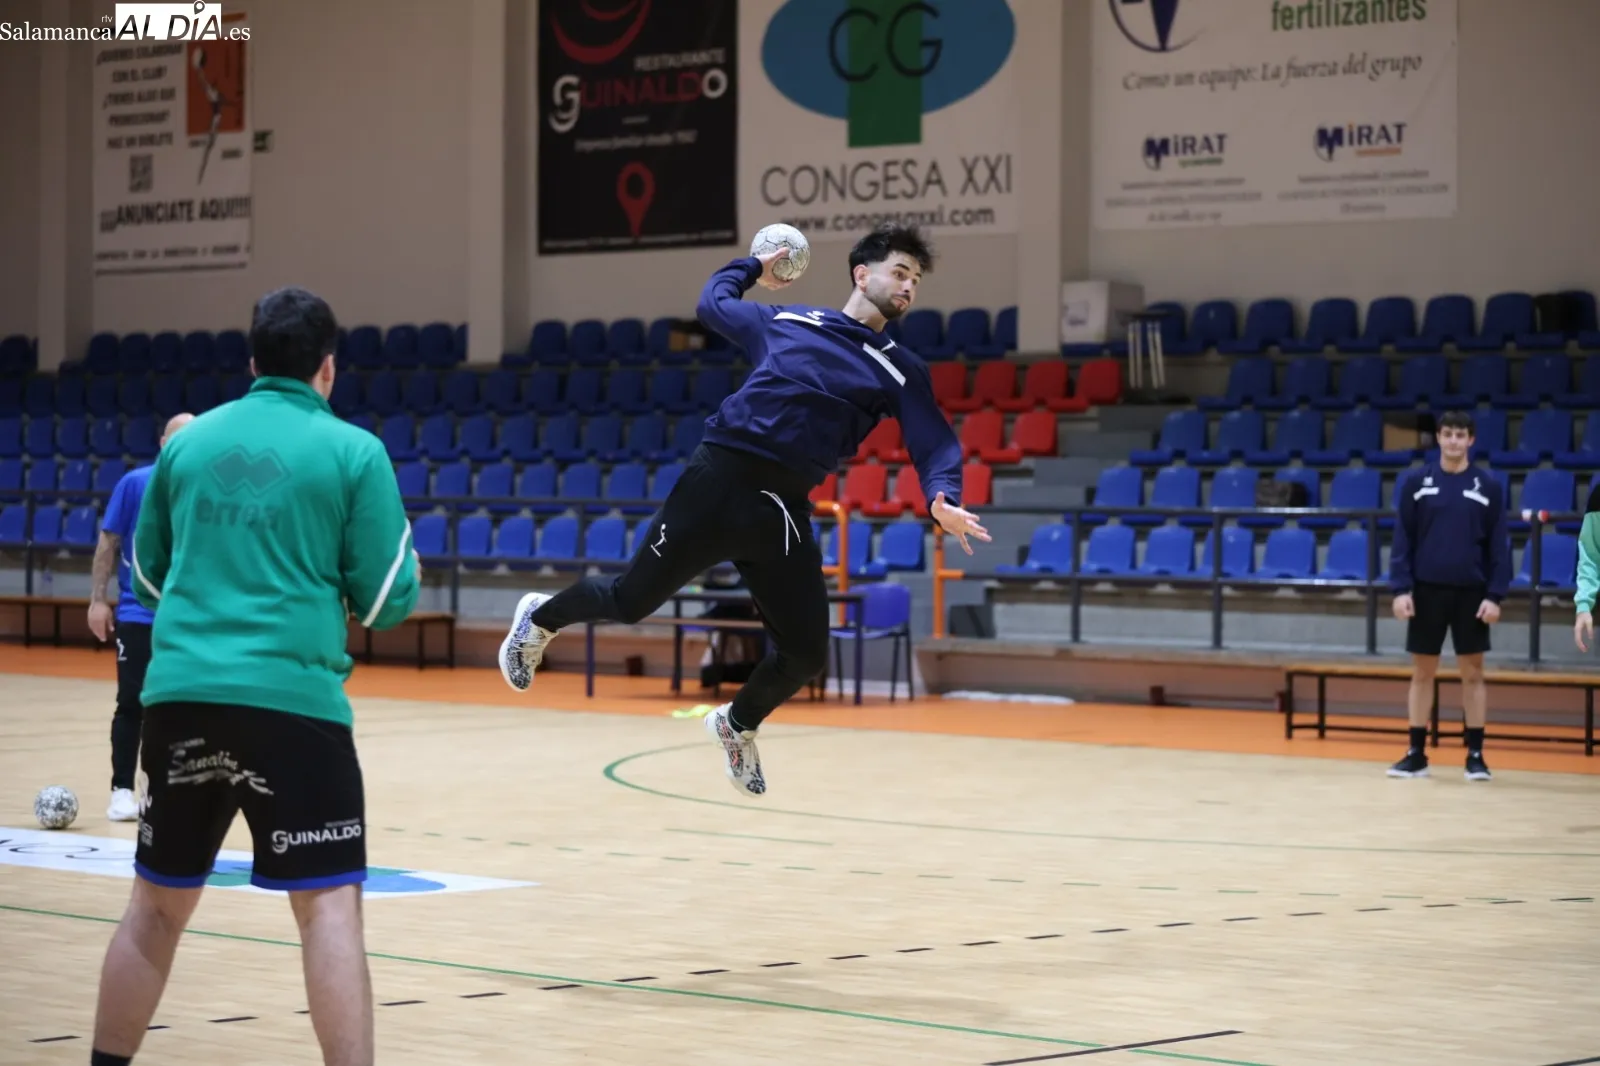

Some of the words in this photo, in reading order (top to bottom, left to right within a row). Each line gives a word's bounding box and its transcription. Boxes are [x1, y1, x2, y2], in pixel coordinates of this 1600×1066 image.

[1271, 0, 1427, 31] fertilizantes
[827, 2, 943, 82] CG
[1122, 71, 1170, 91] Como
[1174, 71, 1195, 86] un
[1261, 62, 1281, 82] La
[1279, 57, 1338, 88] fuerza
[1342, 52, 1367, 75] del
[1368, 54, 1423, 82] grupo
[548, 68, 728, 134] GUINALDO
[761, 159, 948, 206] CONGESA
[960, 154, 1013, 195] XXI
[271, 824, 362, 853] GUINALDO
